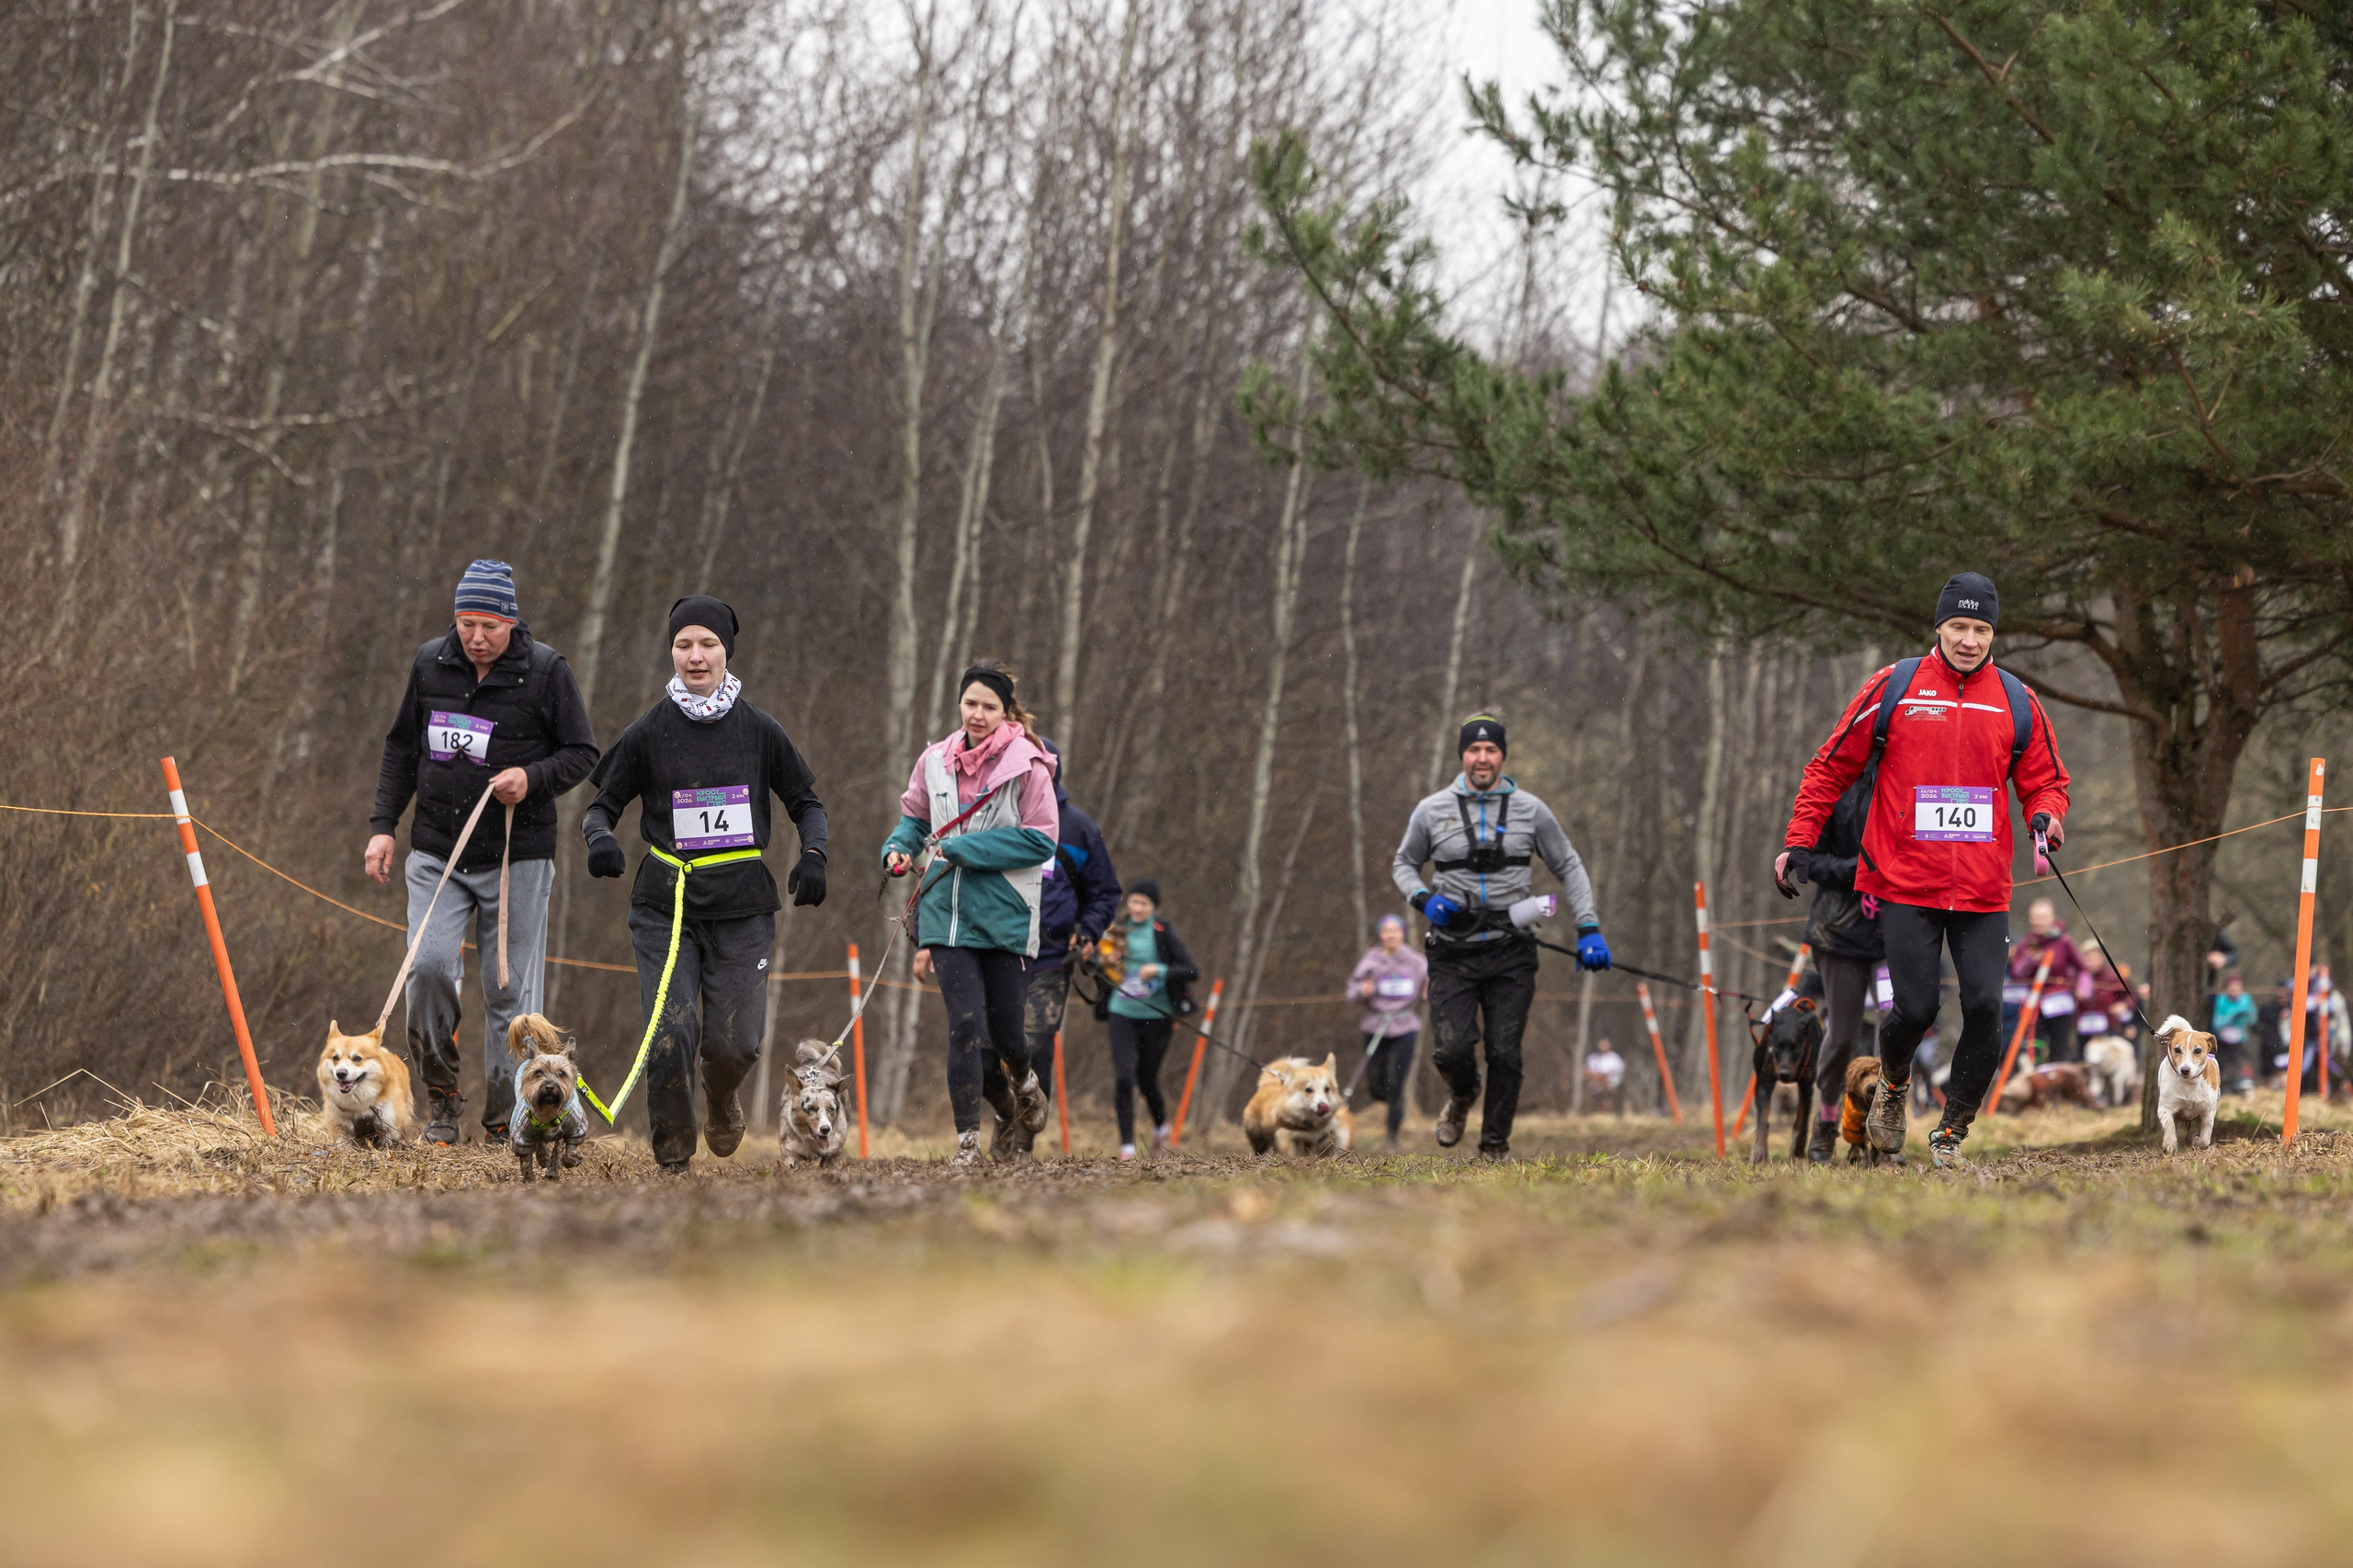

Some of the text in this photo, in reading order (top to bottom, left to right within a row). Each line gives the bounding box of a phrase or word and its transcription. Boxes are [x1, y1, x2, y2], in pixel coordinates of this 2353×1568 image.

[442, 731, 473, 752] 182
[699, 810, 729, 833] 14
[1935, 806, 1976, 828] 140
